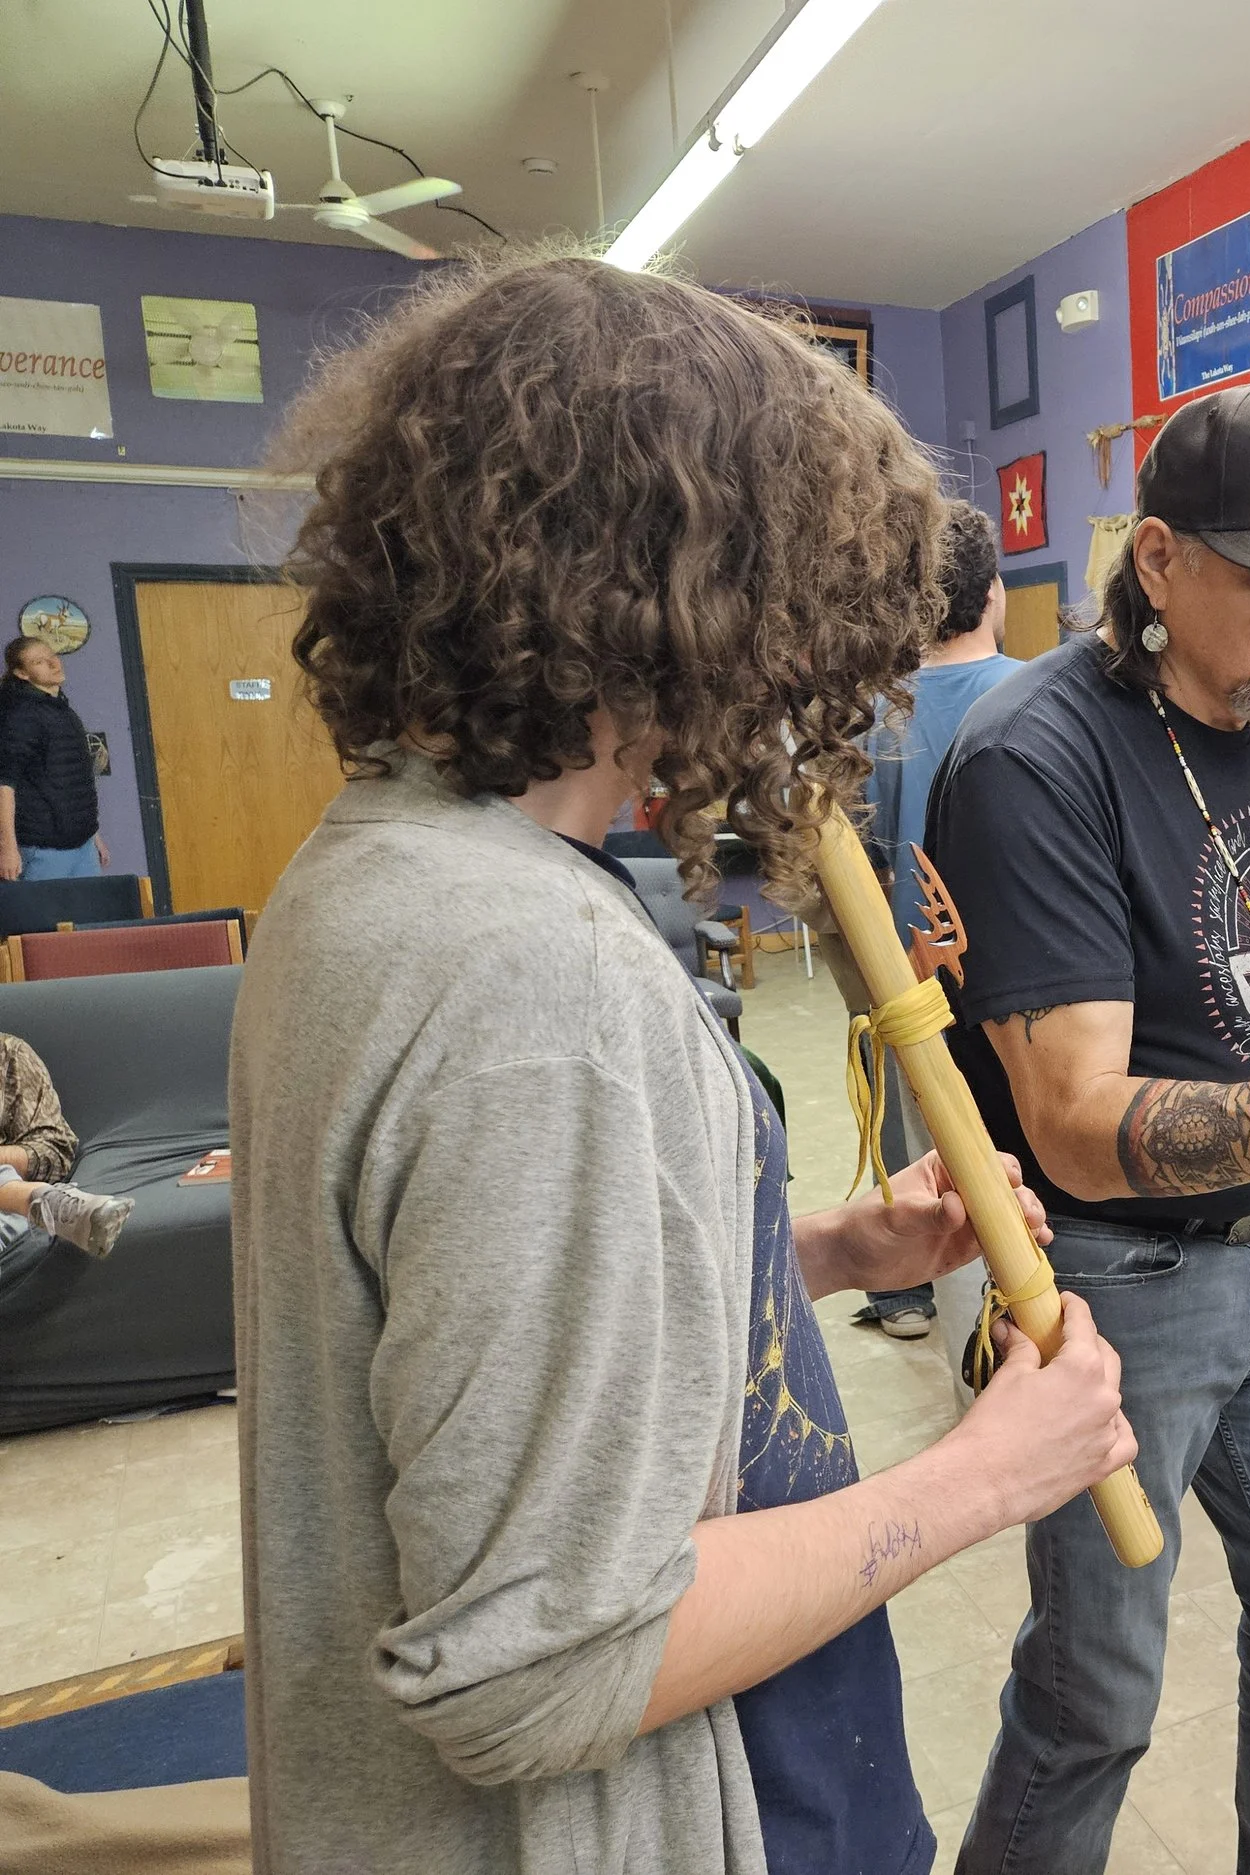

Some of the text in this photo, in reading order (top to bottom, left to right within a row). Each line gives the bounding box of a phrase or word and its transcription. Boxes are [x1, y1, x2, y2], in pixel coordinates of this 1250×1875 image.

[0, 422, 47, 433] akota Way
[1205, 843, 1230, 923] sacrifice
